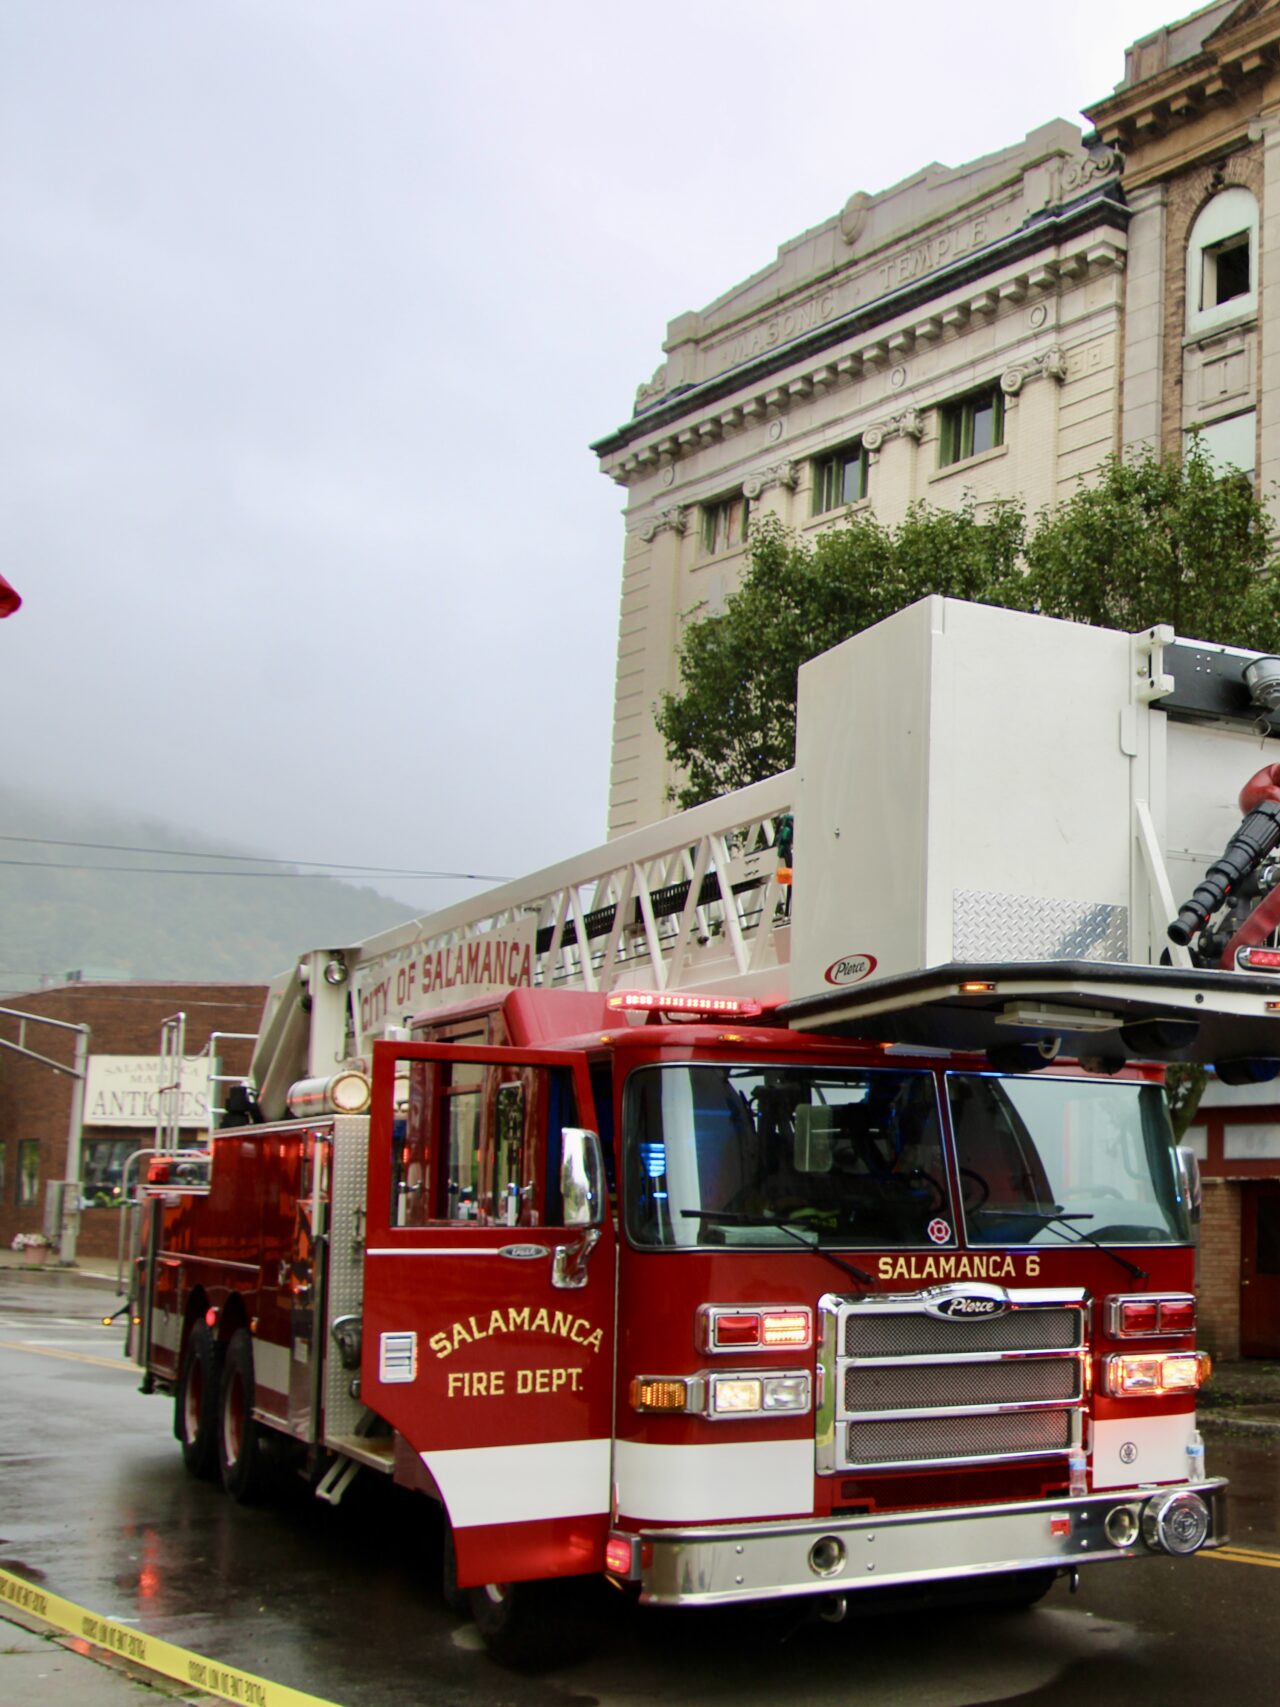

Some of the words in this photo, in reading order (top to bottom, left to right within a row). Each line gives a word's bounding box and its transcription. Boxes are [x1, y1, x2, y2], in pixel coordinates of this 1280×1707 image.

[729, 293, 834, 365] MASONIC
[879, 216, 988, 290] TEMPLE
[834, 961, 865, 980] Pierce
[361, 976, 392, 1033] CITY
[396, 961, 416, 1005] OF
[422, 940, 531, 994] SALAMANCA
[878, 1256, 1016, 1280] SALAMANCA
[1025, 1255, 1041, 1277] 6
[947, 1297, 995, 1316] Pierce
[429, 1307, 604, 1359] SALAMANCA
[448, 1371, 506, 1398] FIRE
[516, 1367, 585, 1395] DEPT.
